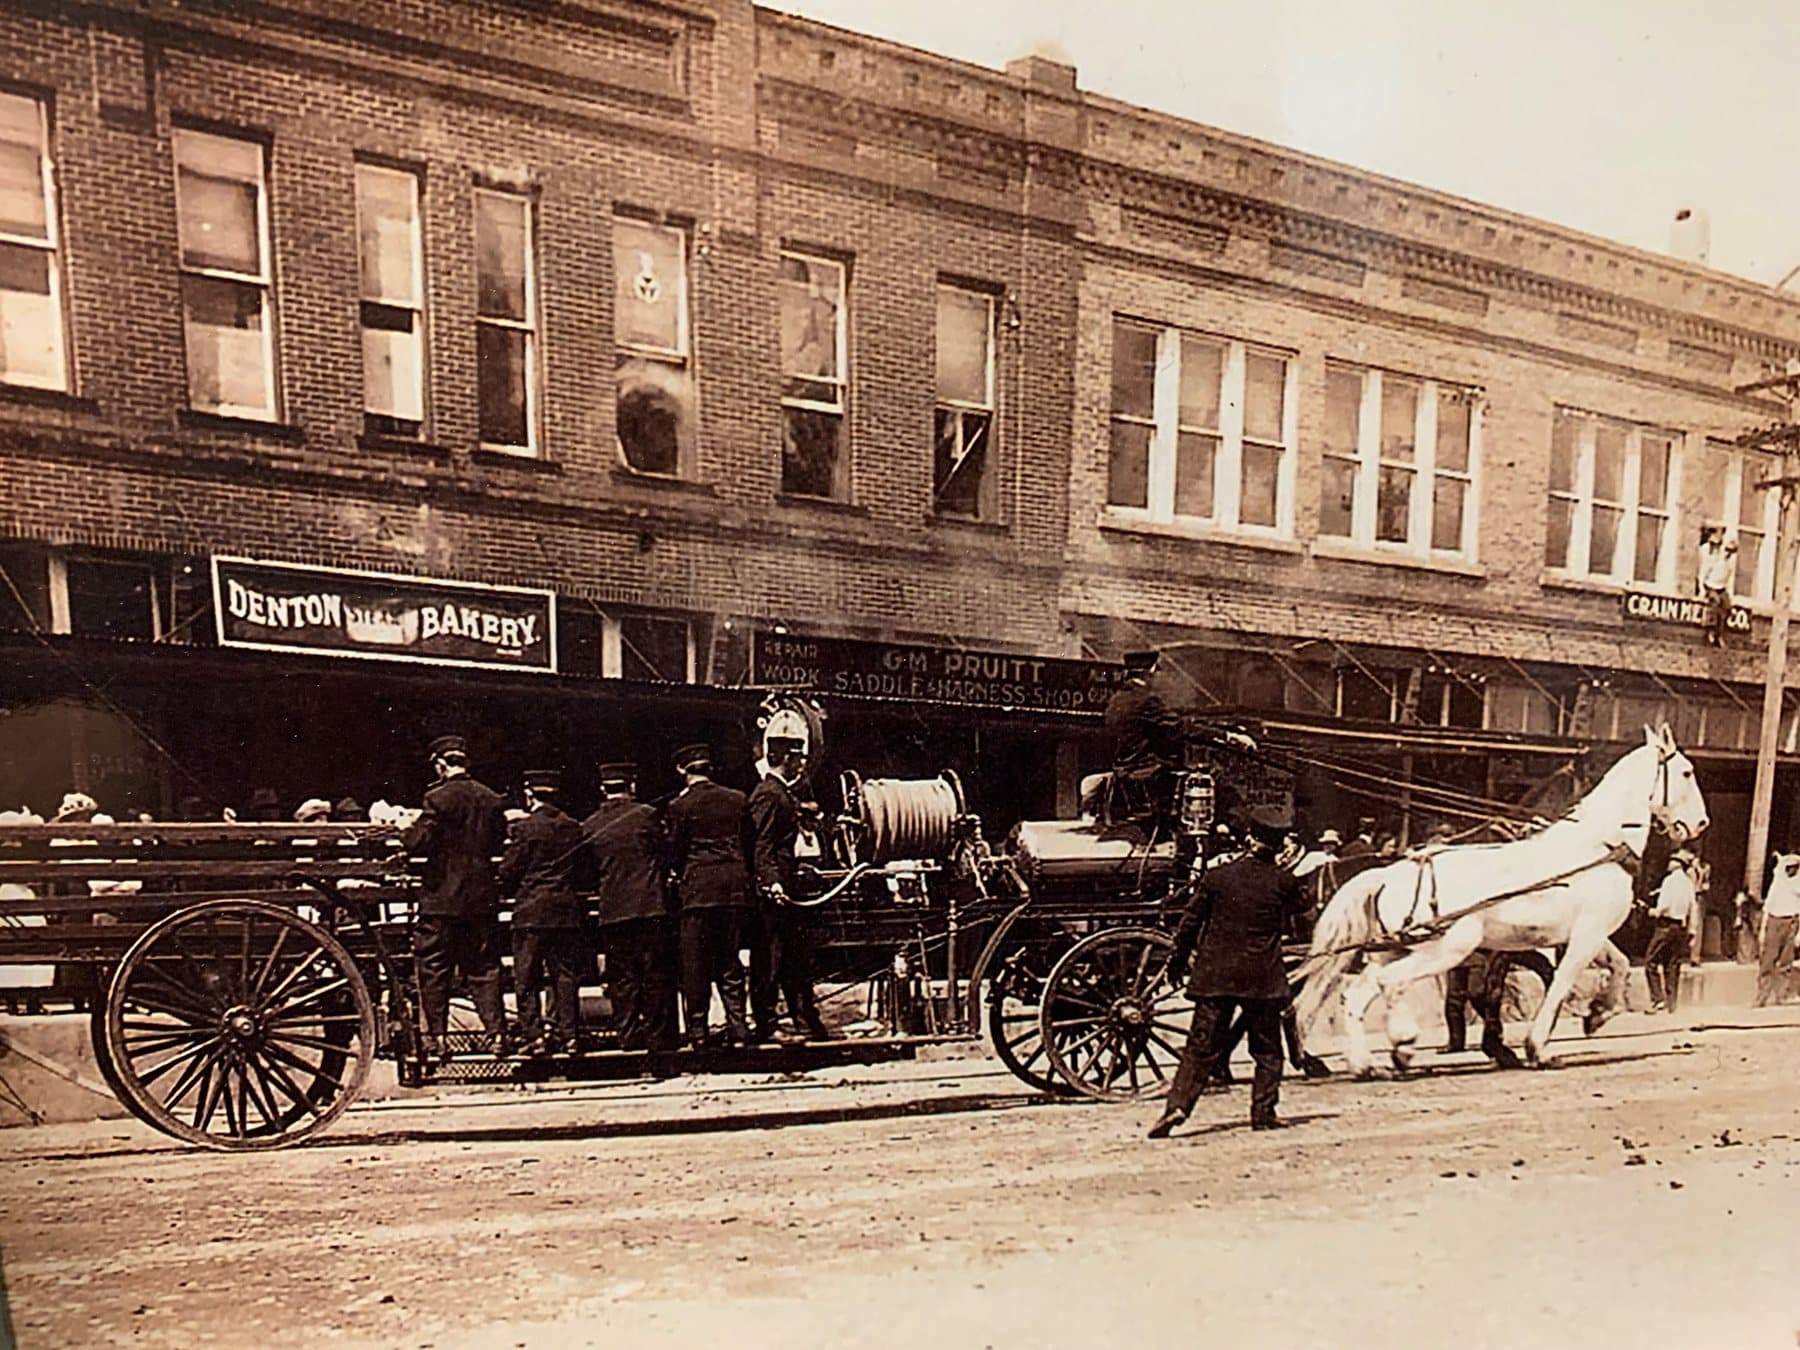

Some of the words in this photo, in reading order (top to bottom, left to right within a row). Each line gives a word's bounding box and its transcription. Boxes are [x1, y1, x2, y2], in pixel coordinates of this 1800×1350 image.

[228, 579, 341, 628] DENTON
[1628, 594, 1678, 618] CRAIN
[764, 640, 818, 658] REPAIR
[762, 663, 820, 684] WORK
[945, 654, 1046, 682] PRUITT
[835, 671, 924, 697] SADDLE
